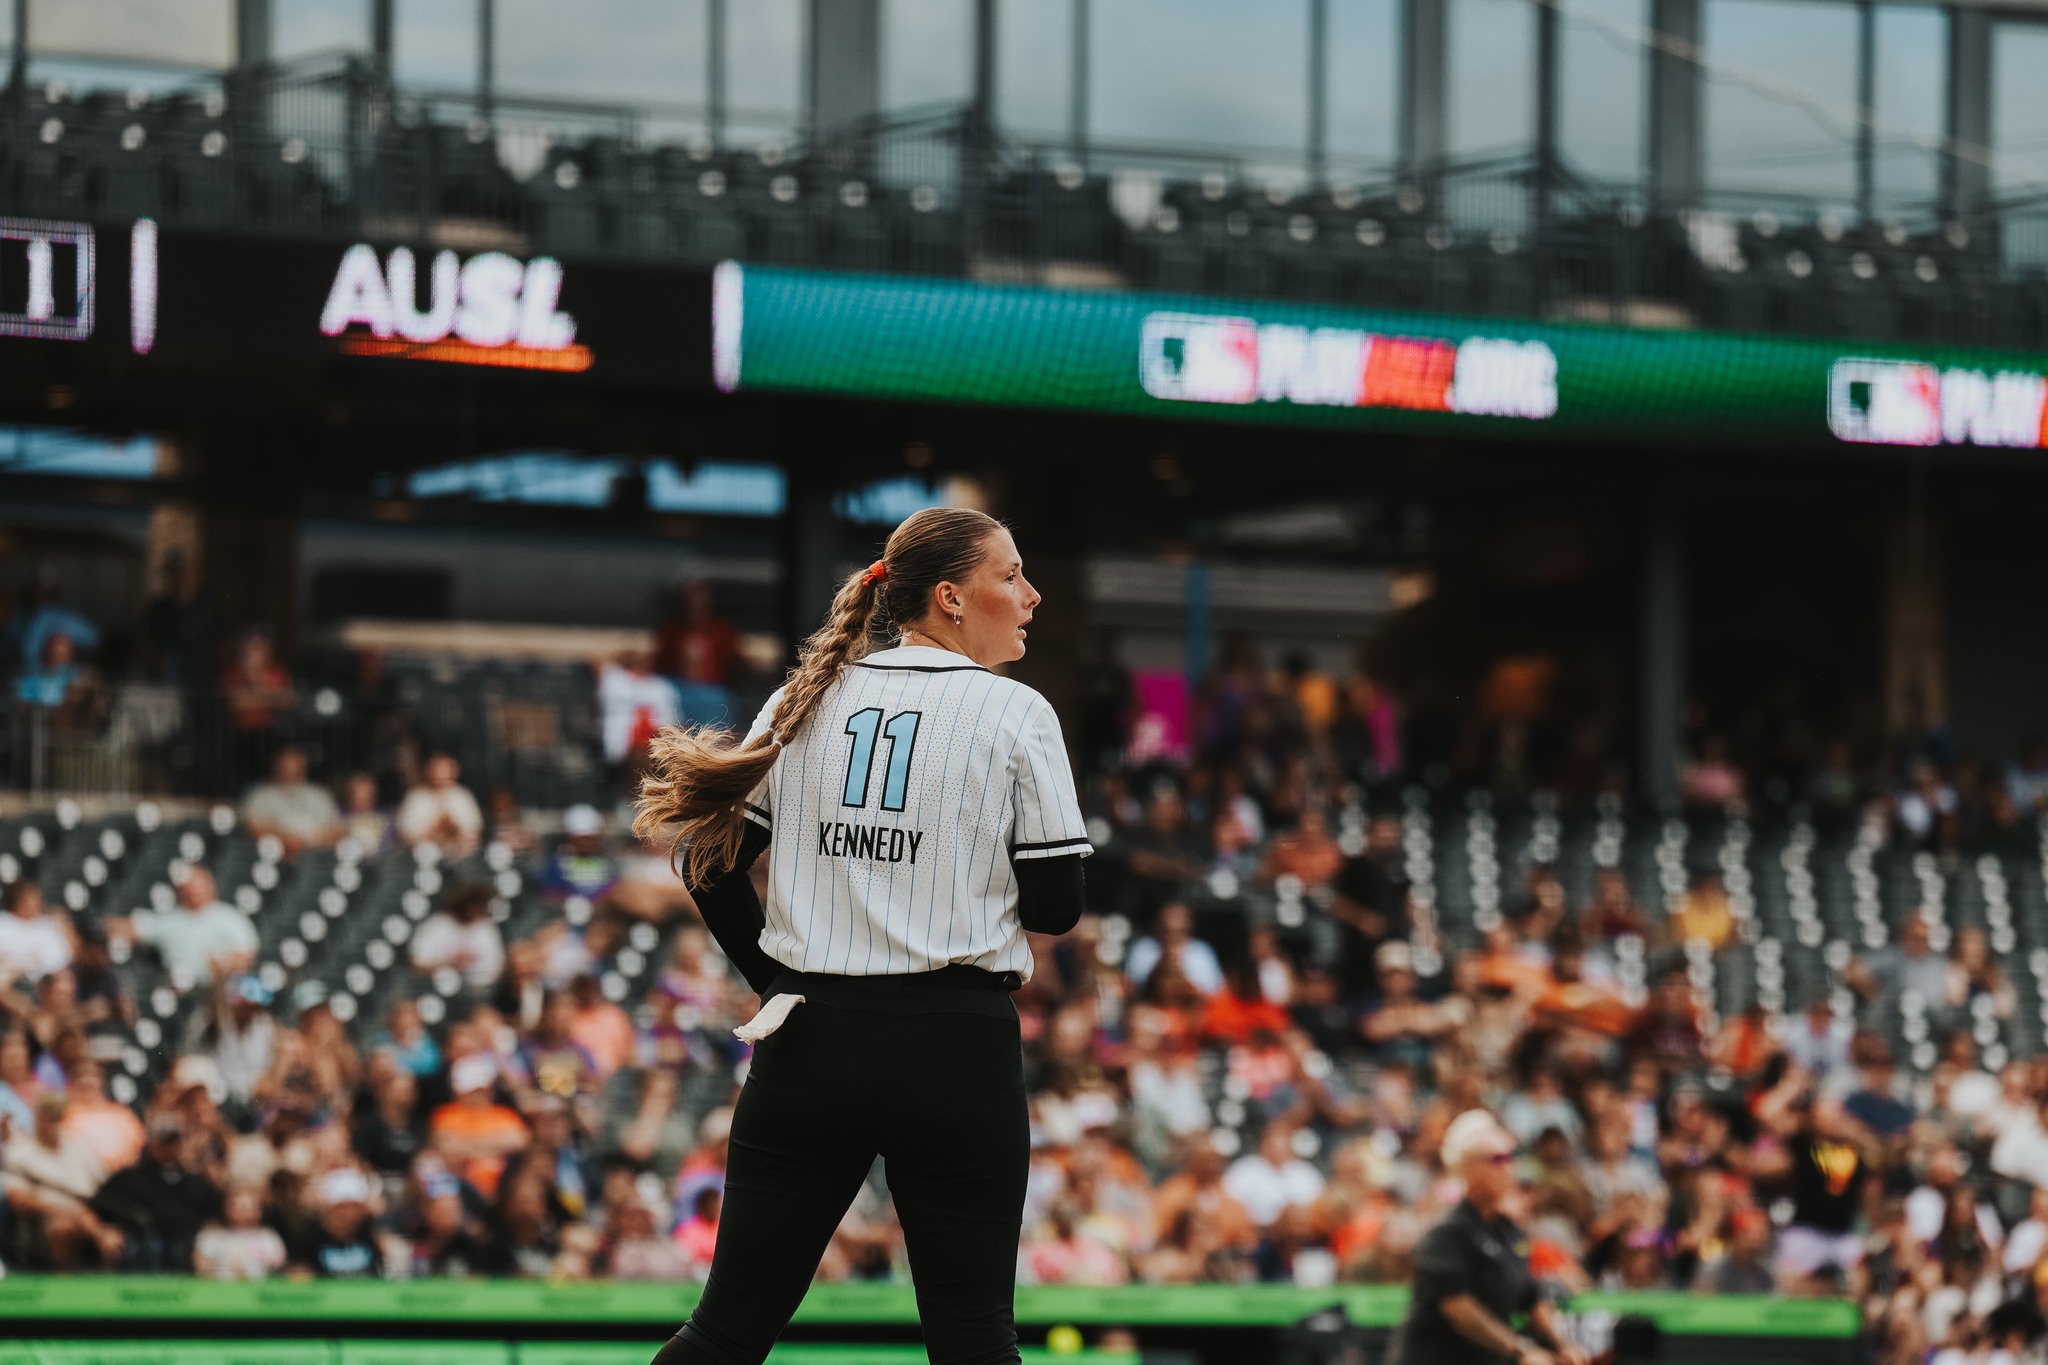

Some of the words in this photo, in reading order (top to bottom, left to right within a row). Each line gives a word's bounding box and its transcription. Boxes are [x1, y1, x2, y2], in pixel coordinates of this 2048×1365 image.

[320, 244, 577, 350] AUSL
[842, 707, 922, 812] 11
[818, 822, 923, 864] KENNEDY
